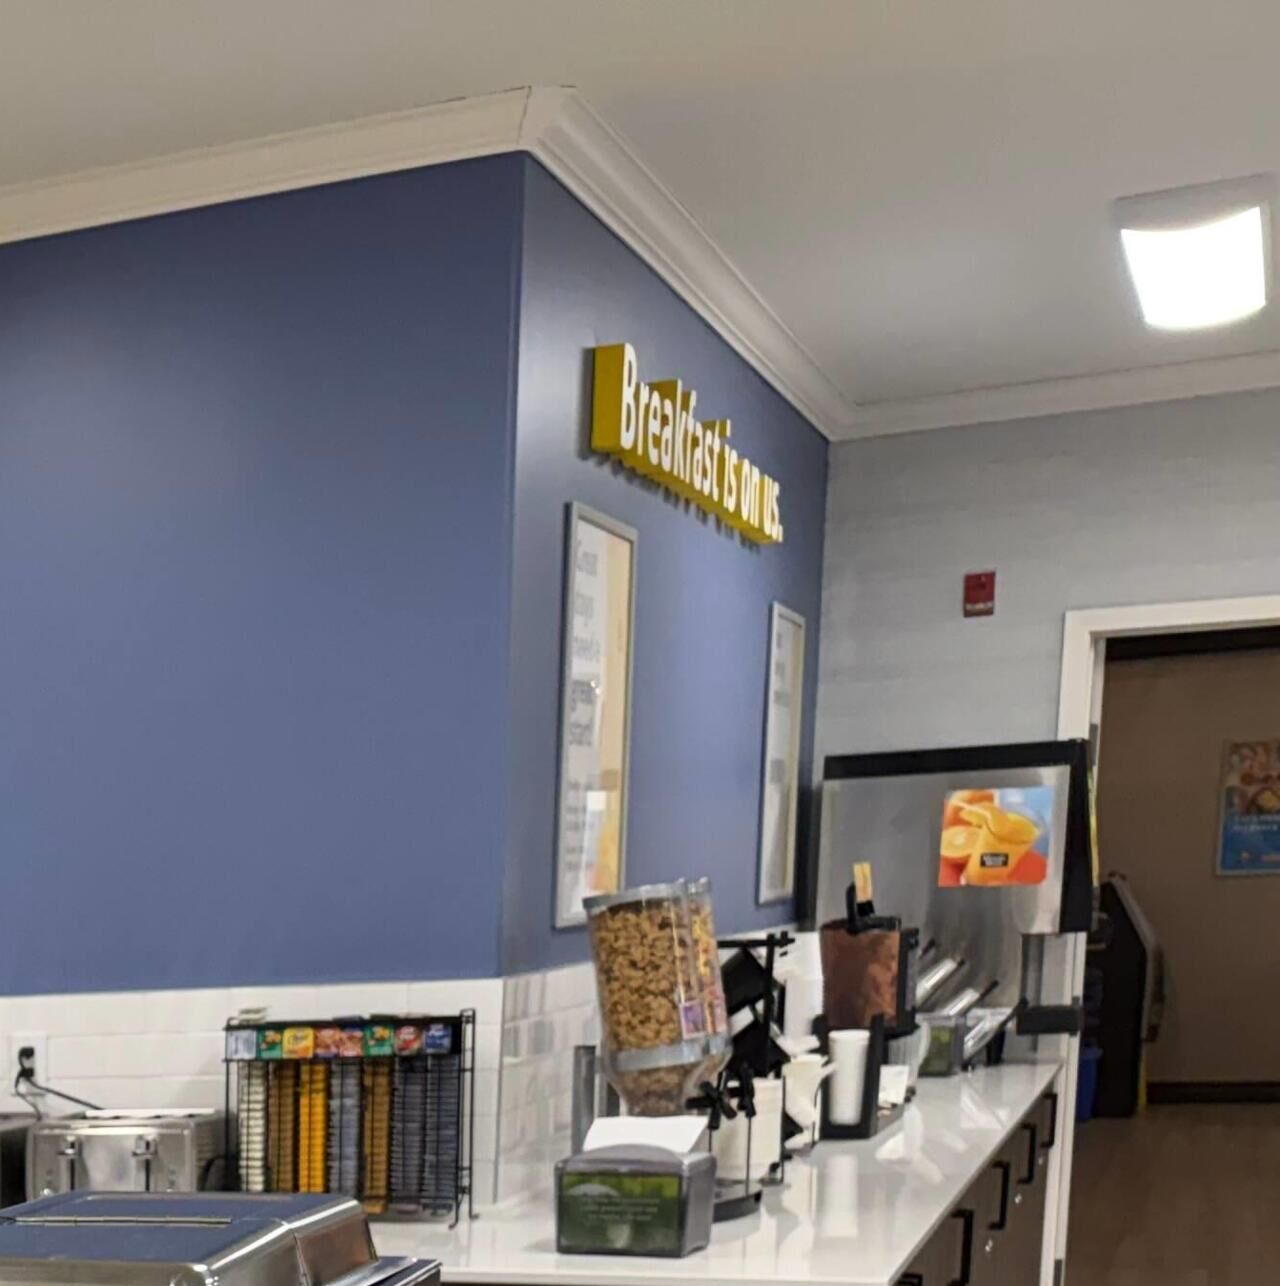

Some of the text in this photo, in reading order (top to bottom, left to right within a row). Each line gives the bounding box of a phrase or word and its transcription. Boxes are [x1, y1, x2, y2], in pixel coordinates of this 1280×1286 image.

[620, 342, 784, 543] Breakfast is on us.
